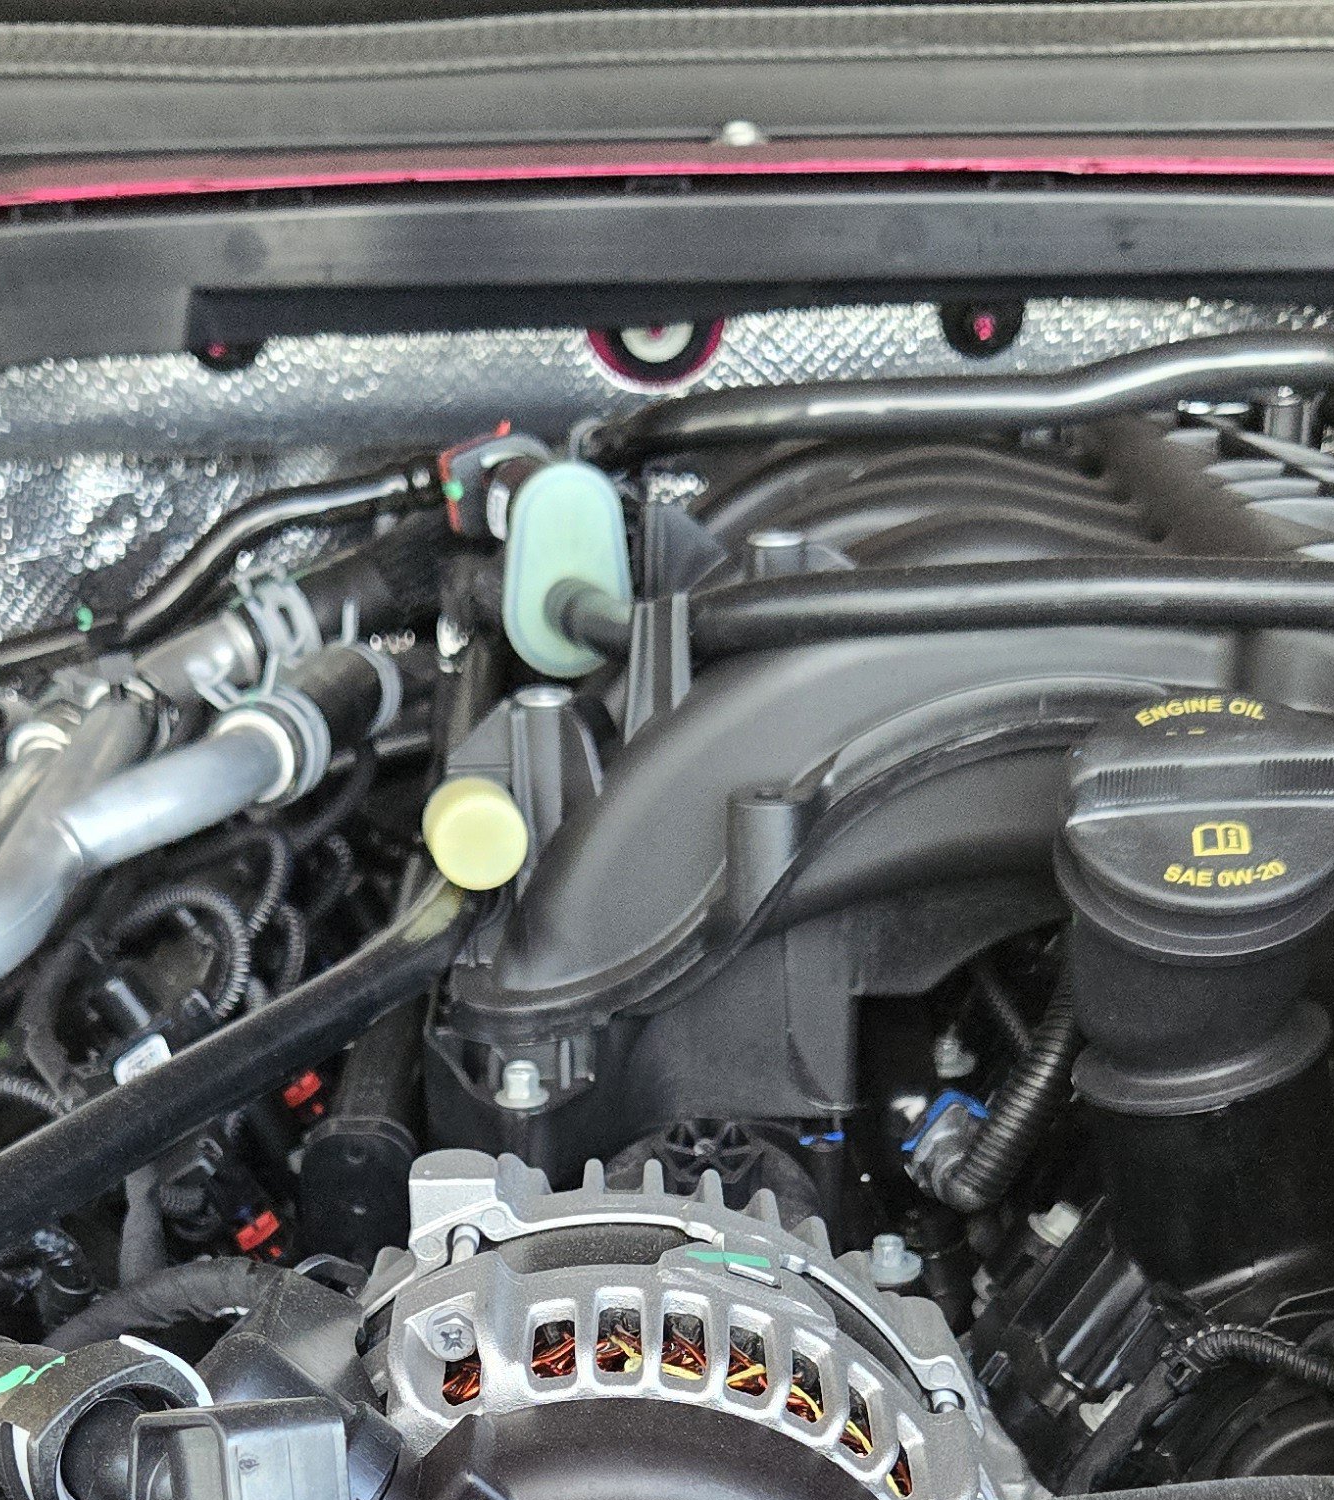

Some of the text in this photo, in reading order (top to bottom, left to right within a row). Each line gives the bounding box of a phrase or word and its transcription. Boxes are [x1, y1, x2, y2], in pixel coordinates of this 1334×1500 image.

[1135, 696, 1265, 727] ENGINE OIL
[1163, 860, 1287, 888] SAE 0W-20
